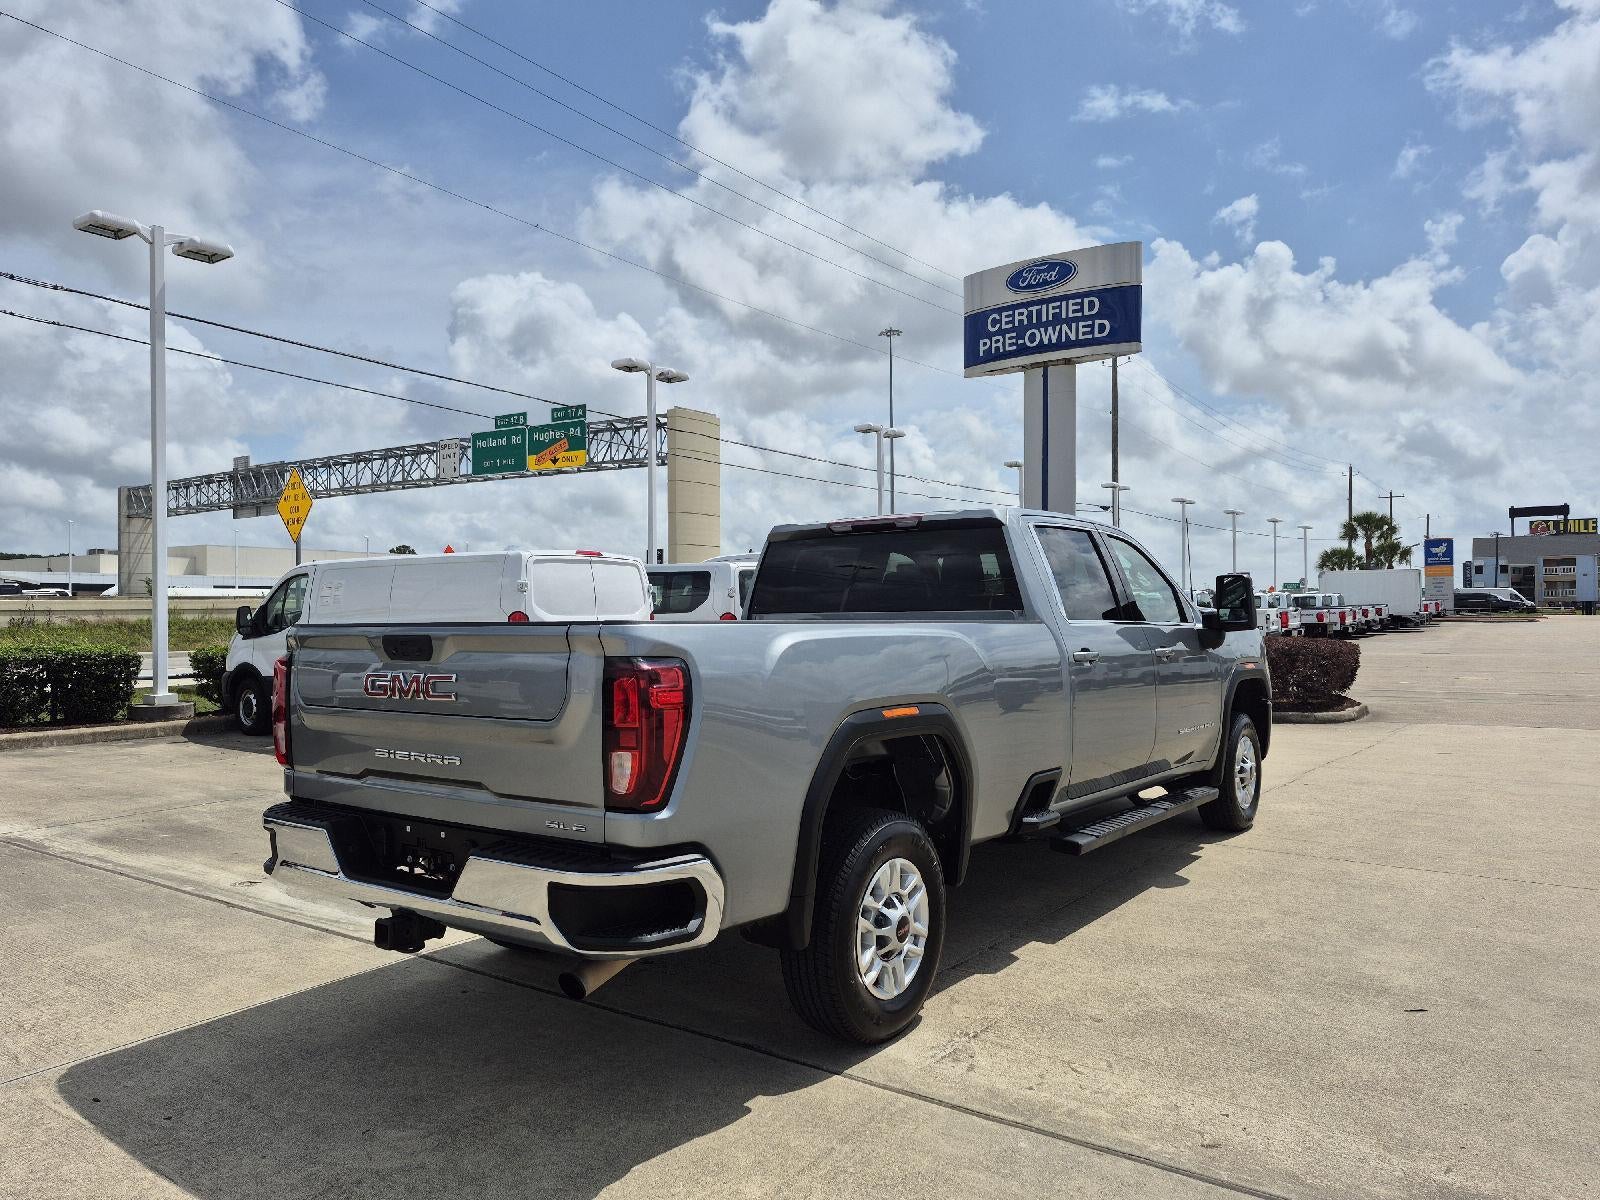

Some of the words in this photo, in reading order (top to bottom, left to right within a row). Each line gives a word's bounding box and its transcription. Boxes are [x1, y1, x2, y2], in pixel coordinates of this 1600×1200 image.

[1018, 263, 1060, 287] Ford
[987, 296, 1100, 332] CERTIFIED
[979, 319, 1111, 357] PRE-OWNED
[476, 436, 507, 449] Holland
[511, 434, 522, 444] Rd
[533, 429, 565, 442] Hughes
[569, 426, 581, 437] Rd
[561, 455, 579, 463] ONLY
[363, 672, 458, 701] GMC
[374, 748, 462, 766] SIERRA
